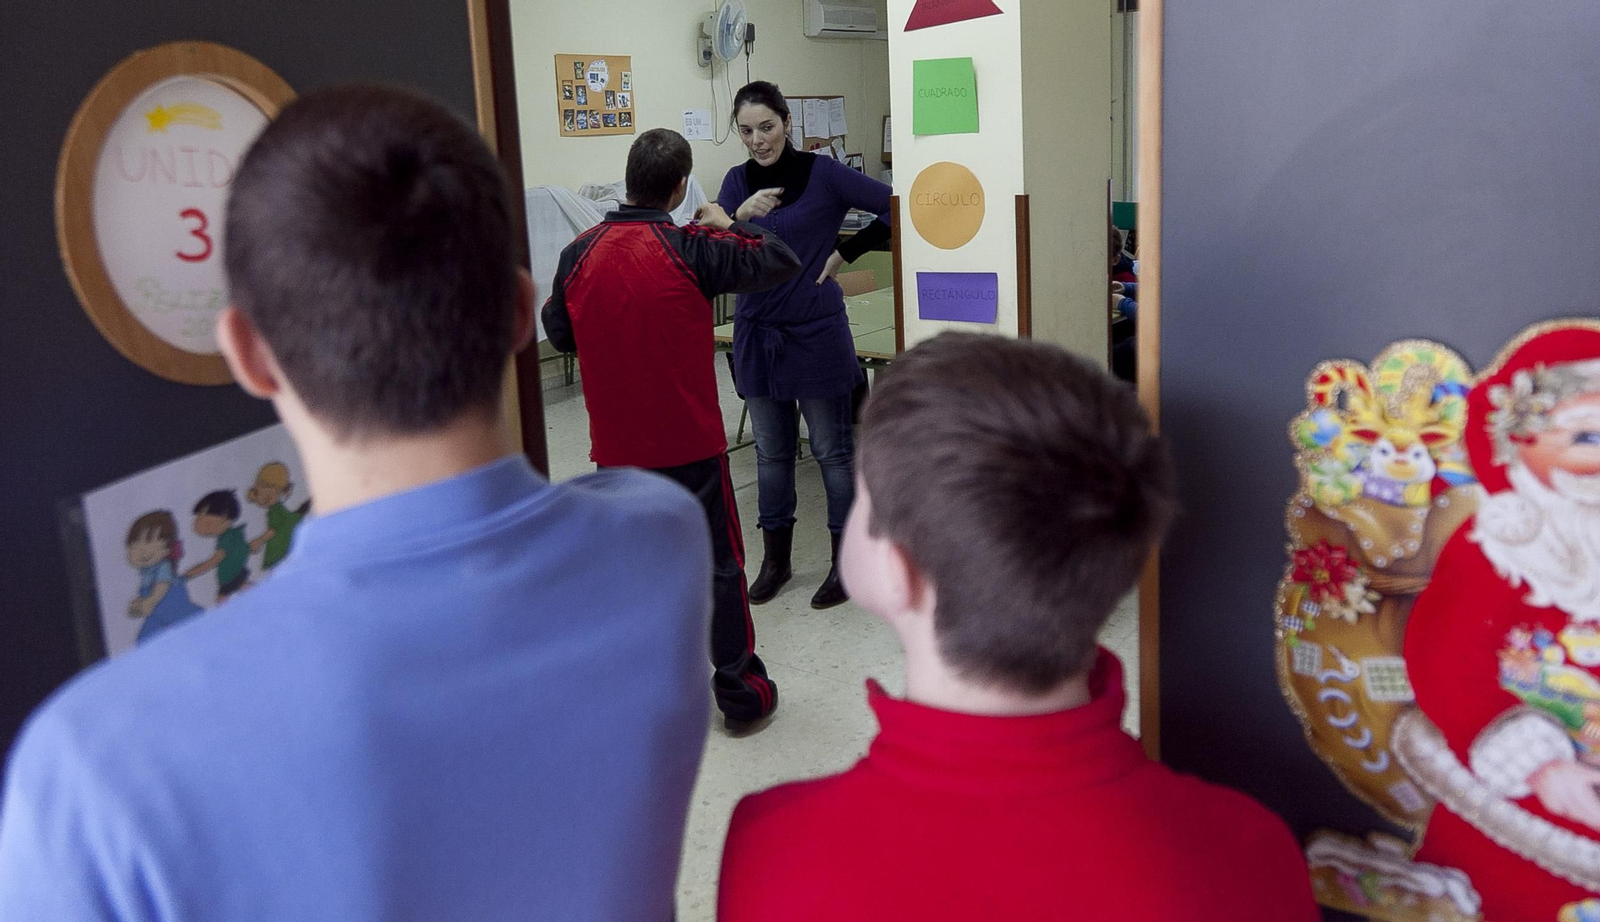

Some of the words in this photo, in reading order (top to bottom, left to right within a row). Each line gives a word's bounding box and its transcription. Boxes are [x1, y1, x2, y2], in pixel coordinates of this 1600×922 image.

[918, 86, 968, 98] CUADRADO
[114, 145, 237, 189] UNID
[915, 191, 981, 207] CÍRCULO
[174, 206, 213, 263] 3
[921, 287, 997, 301] RECTÁNGULO
